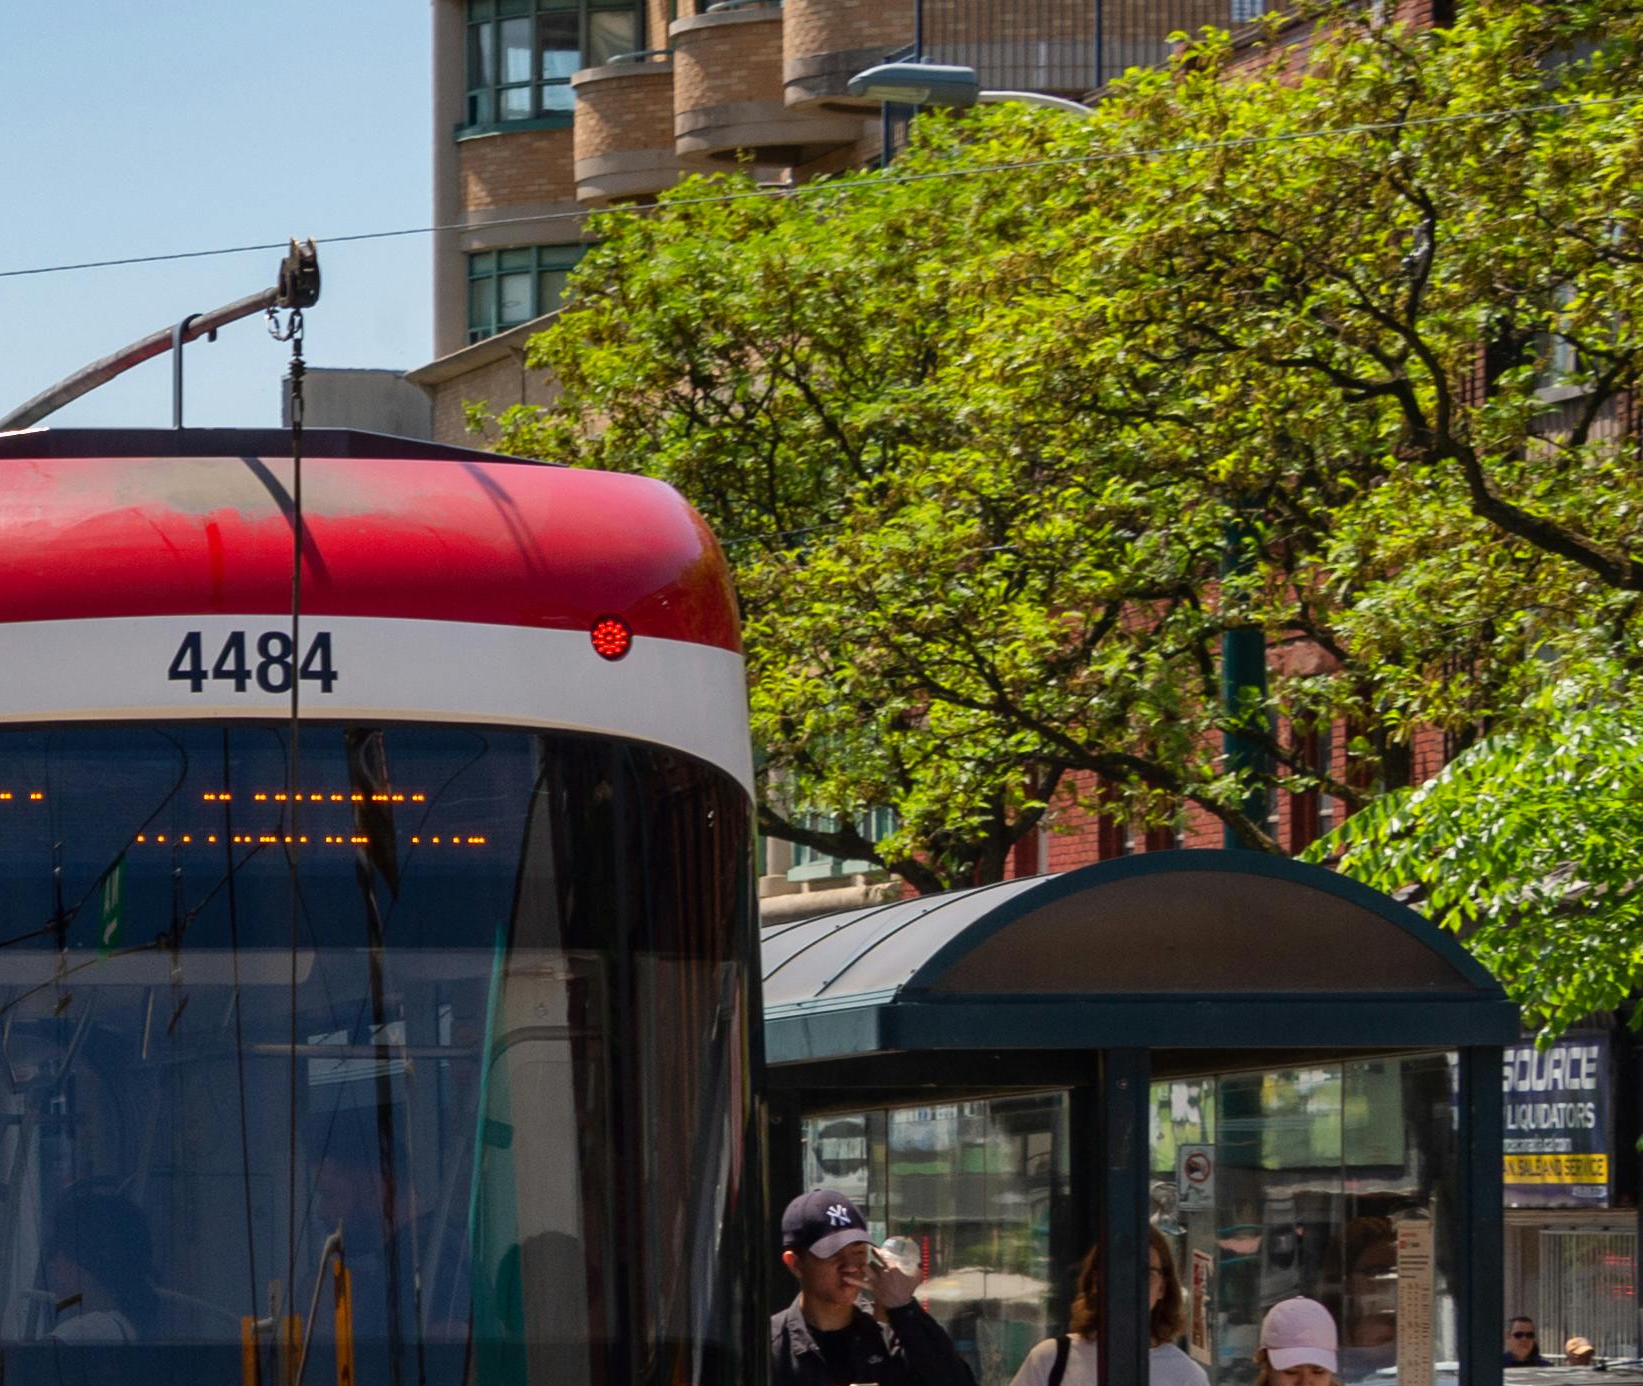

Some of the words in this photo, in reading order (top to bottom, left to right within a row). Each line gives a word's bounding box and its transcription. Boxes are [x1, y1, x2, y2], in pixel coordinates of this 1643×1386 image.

[168, 631, 339, 693] 4484
[1503, 1046, 1598, 1092] SOURCE
[1506, 1102, 1595, 1131] LIQUIDATORS
